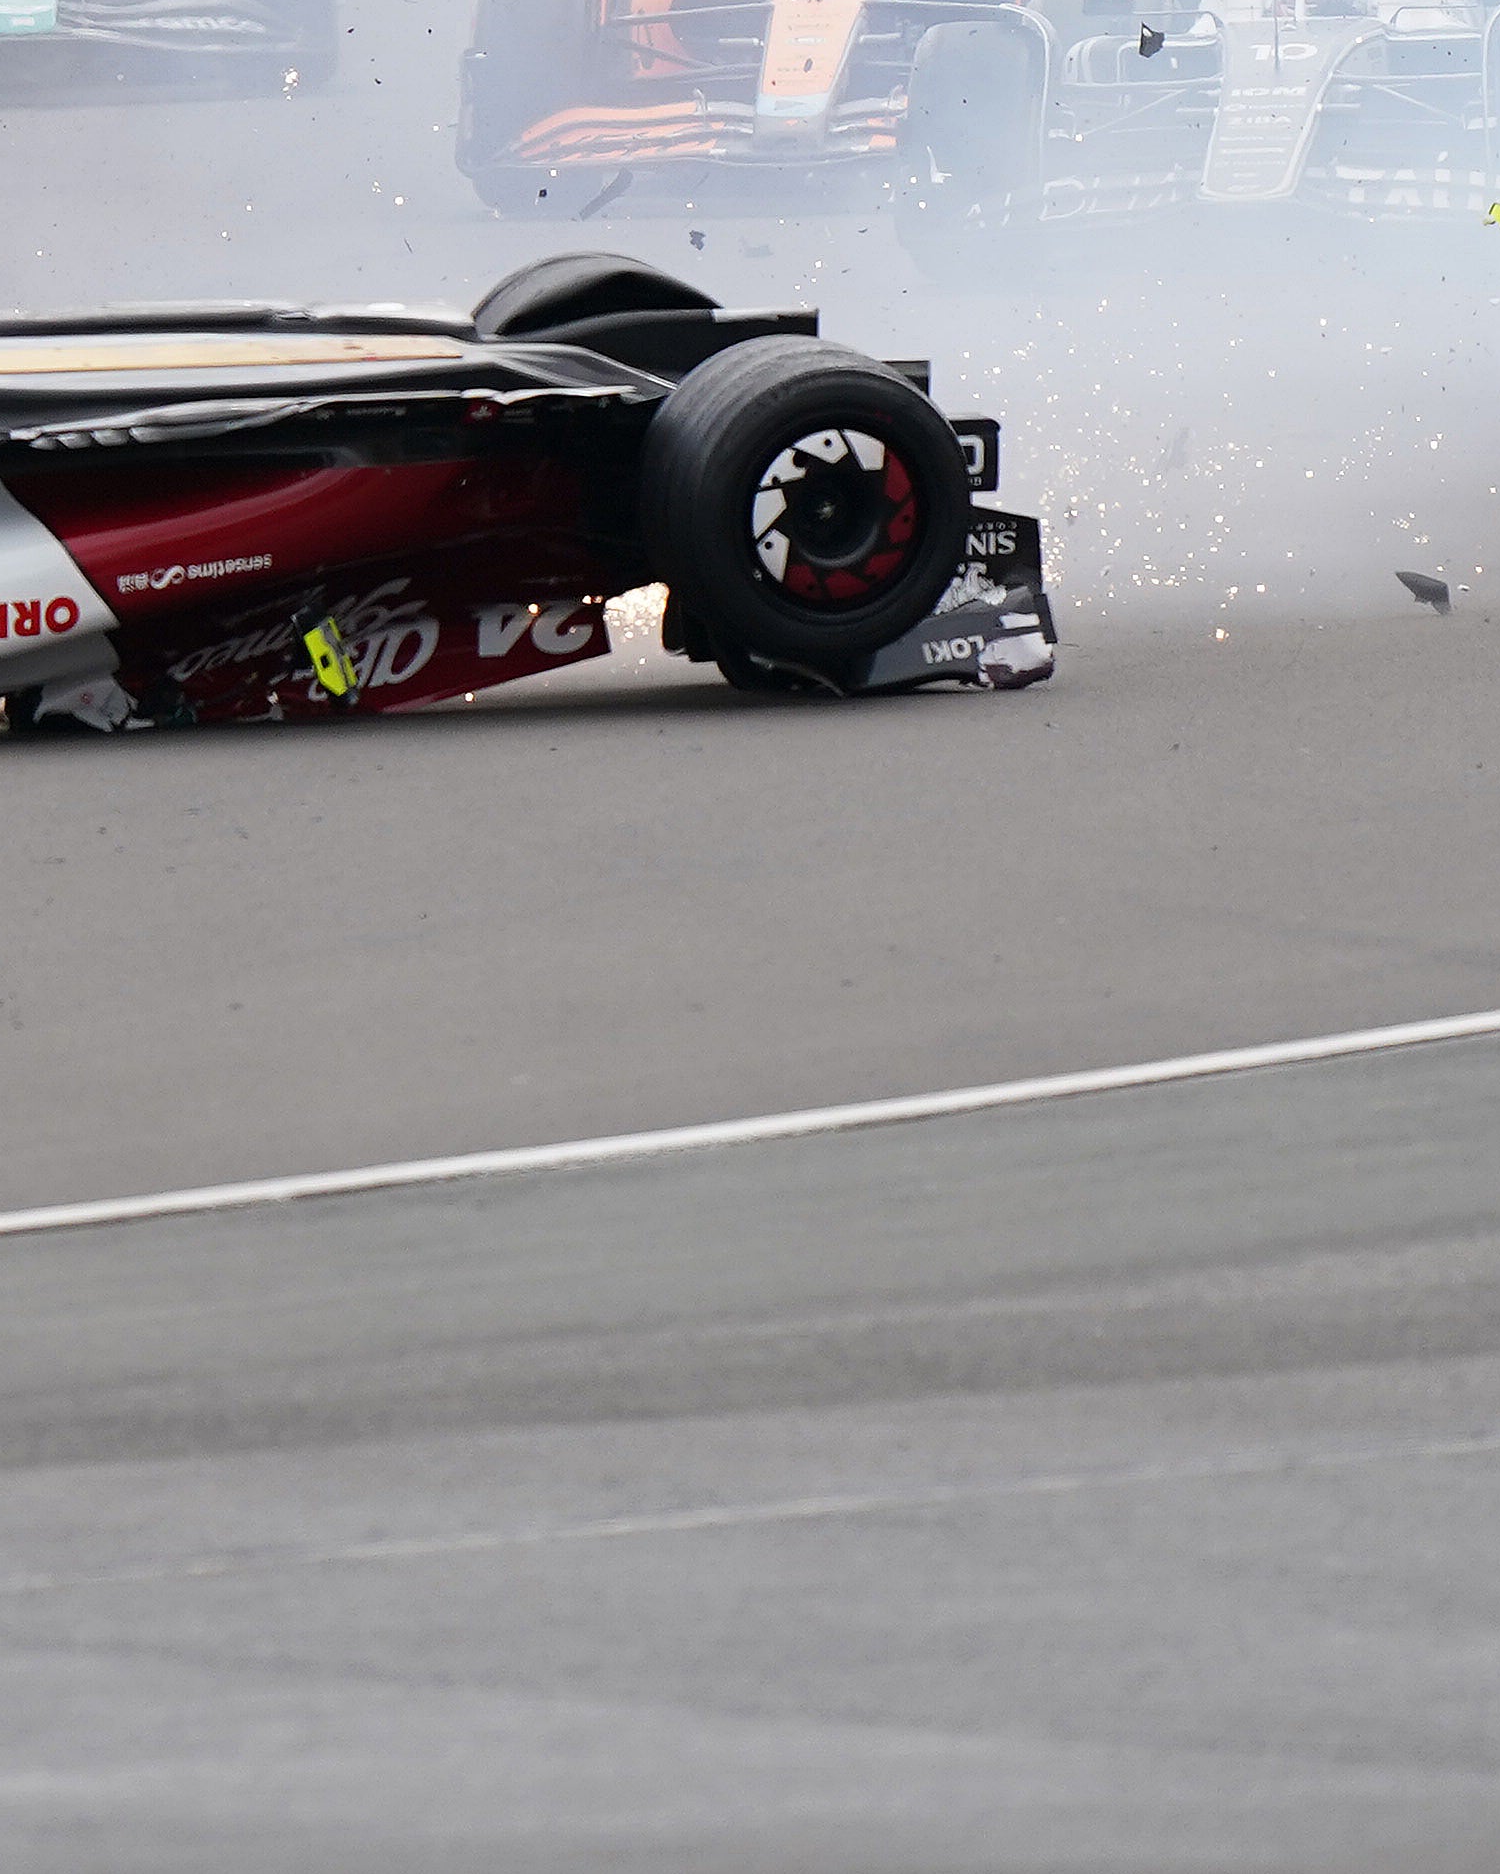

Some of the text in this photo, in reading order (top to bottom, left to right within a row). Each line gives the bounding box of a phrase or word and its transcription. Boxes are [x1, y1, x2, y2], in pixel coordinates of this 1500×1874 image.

[1249, 42, 1317, 61] 10
[475, 600, 594, 657] 24
[910, 634, 986, 664] LOKI
